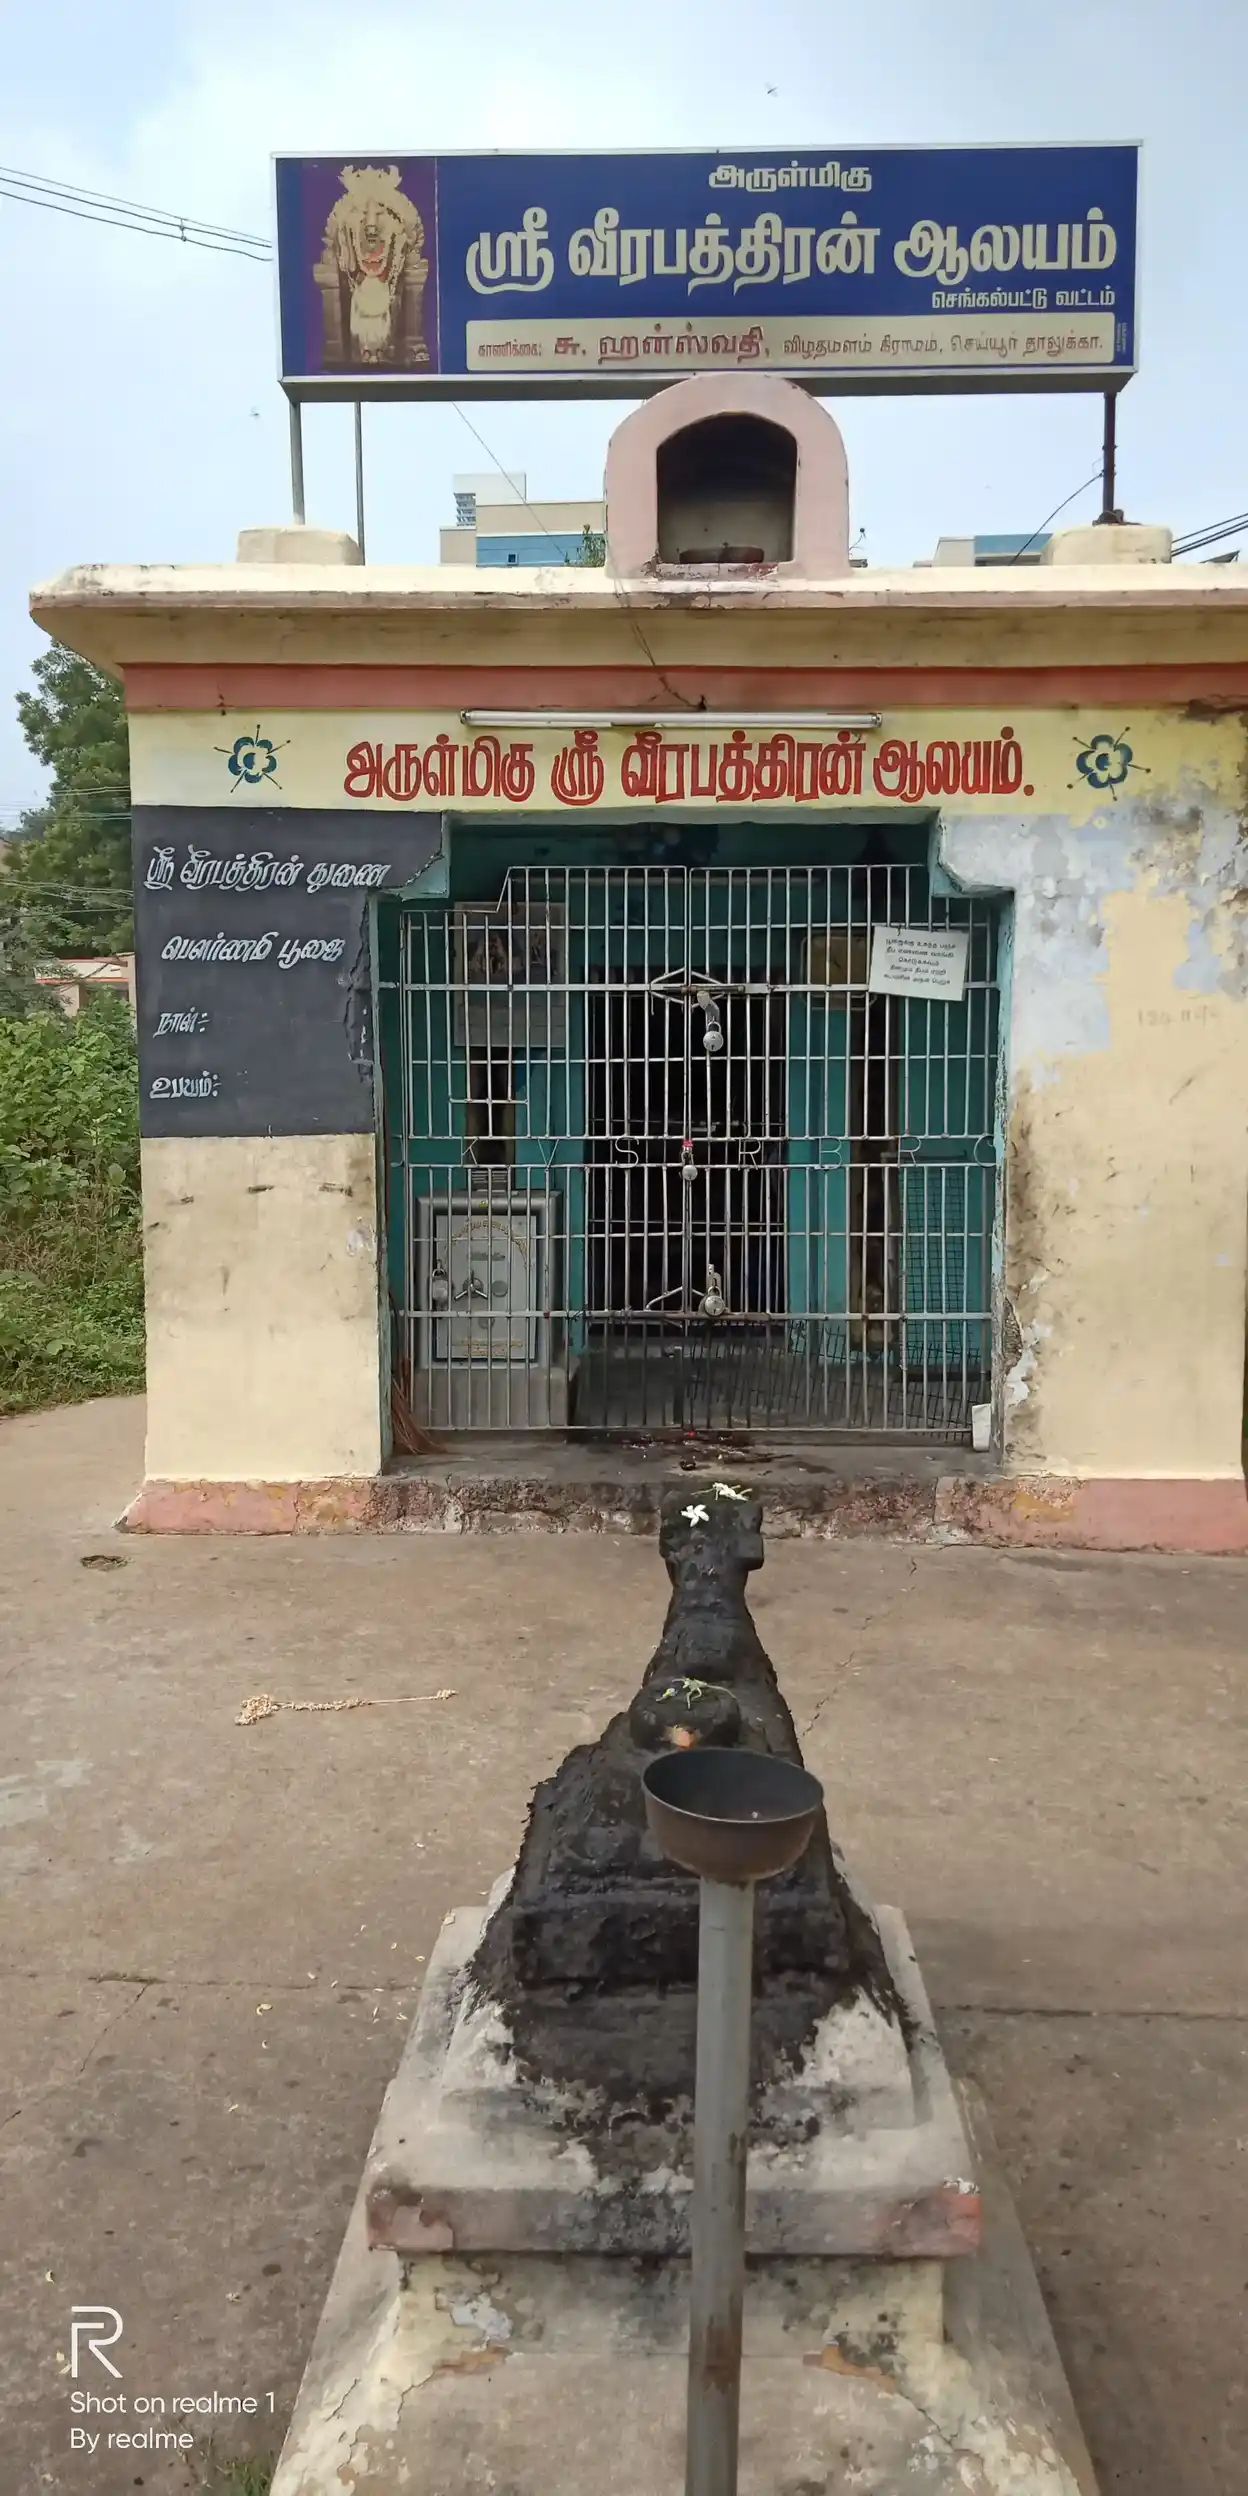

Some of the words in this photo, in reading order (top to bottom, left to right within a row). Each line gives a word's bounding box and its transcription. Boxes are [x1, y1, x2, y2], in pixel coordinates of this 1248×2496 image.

[708, 160, 873, 193] அருள்மிகு
[568, 206, 881, 297] வீரபத்திரன்
[893, 206, 1118, 286] ஆலயம்
[931, 286, 1048, 310] செங்கல்பட்டு
[1055, 284, 1116, 306] வட்டம்
[343, 733, 536, 803] அருள்மிகு
[620, 729, 867, 804] வீரபத்திரன்
[872, 725, 1035, 804] ஆலயம்.
[179, 844, 305, 892] வீரபத்திரன்
[306, 861, 392, 894] துணை
[276, 938, 346, 969] பூஜை
